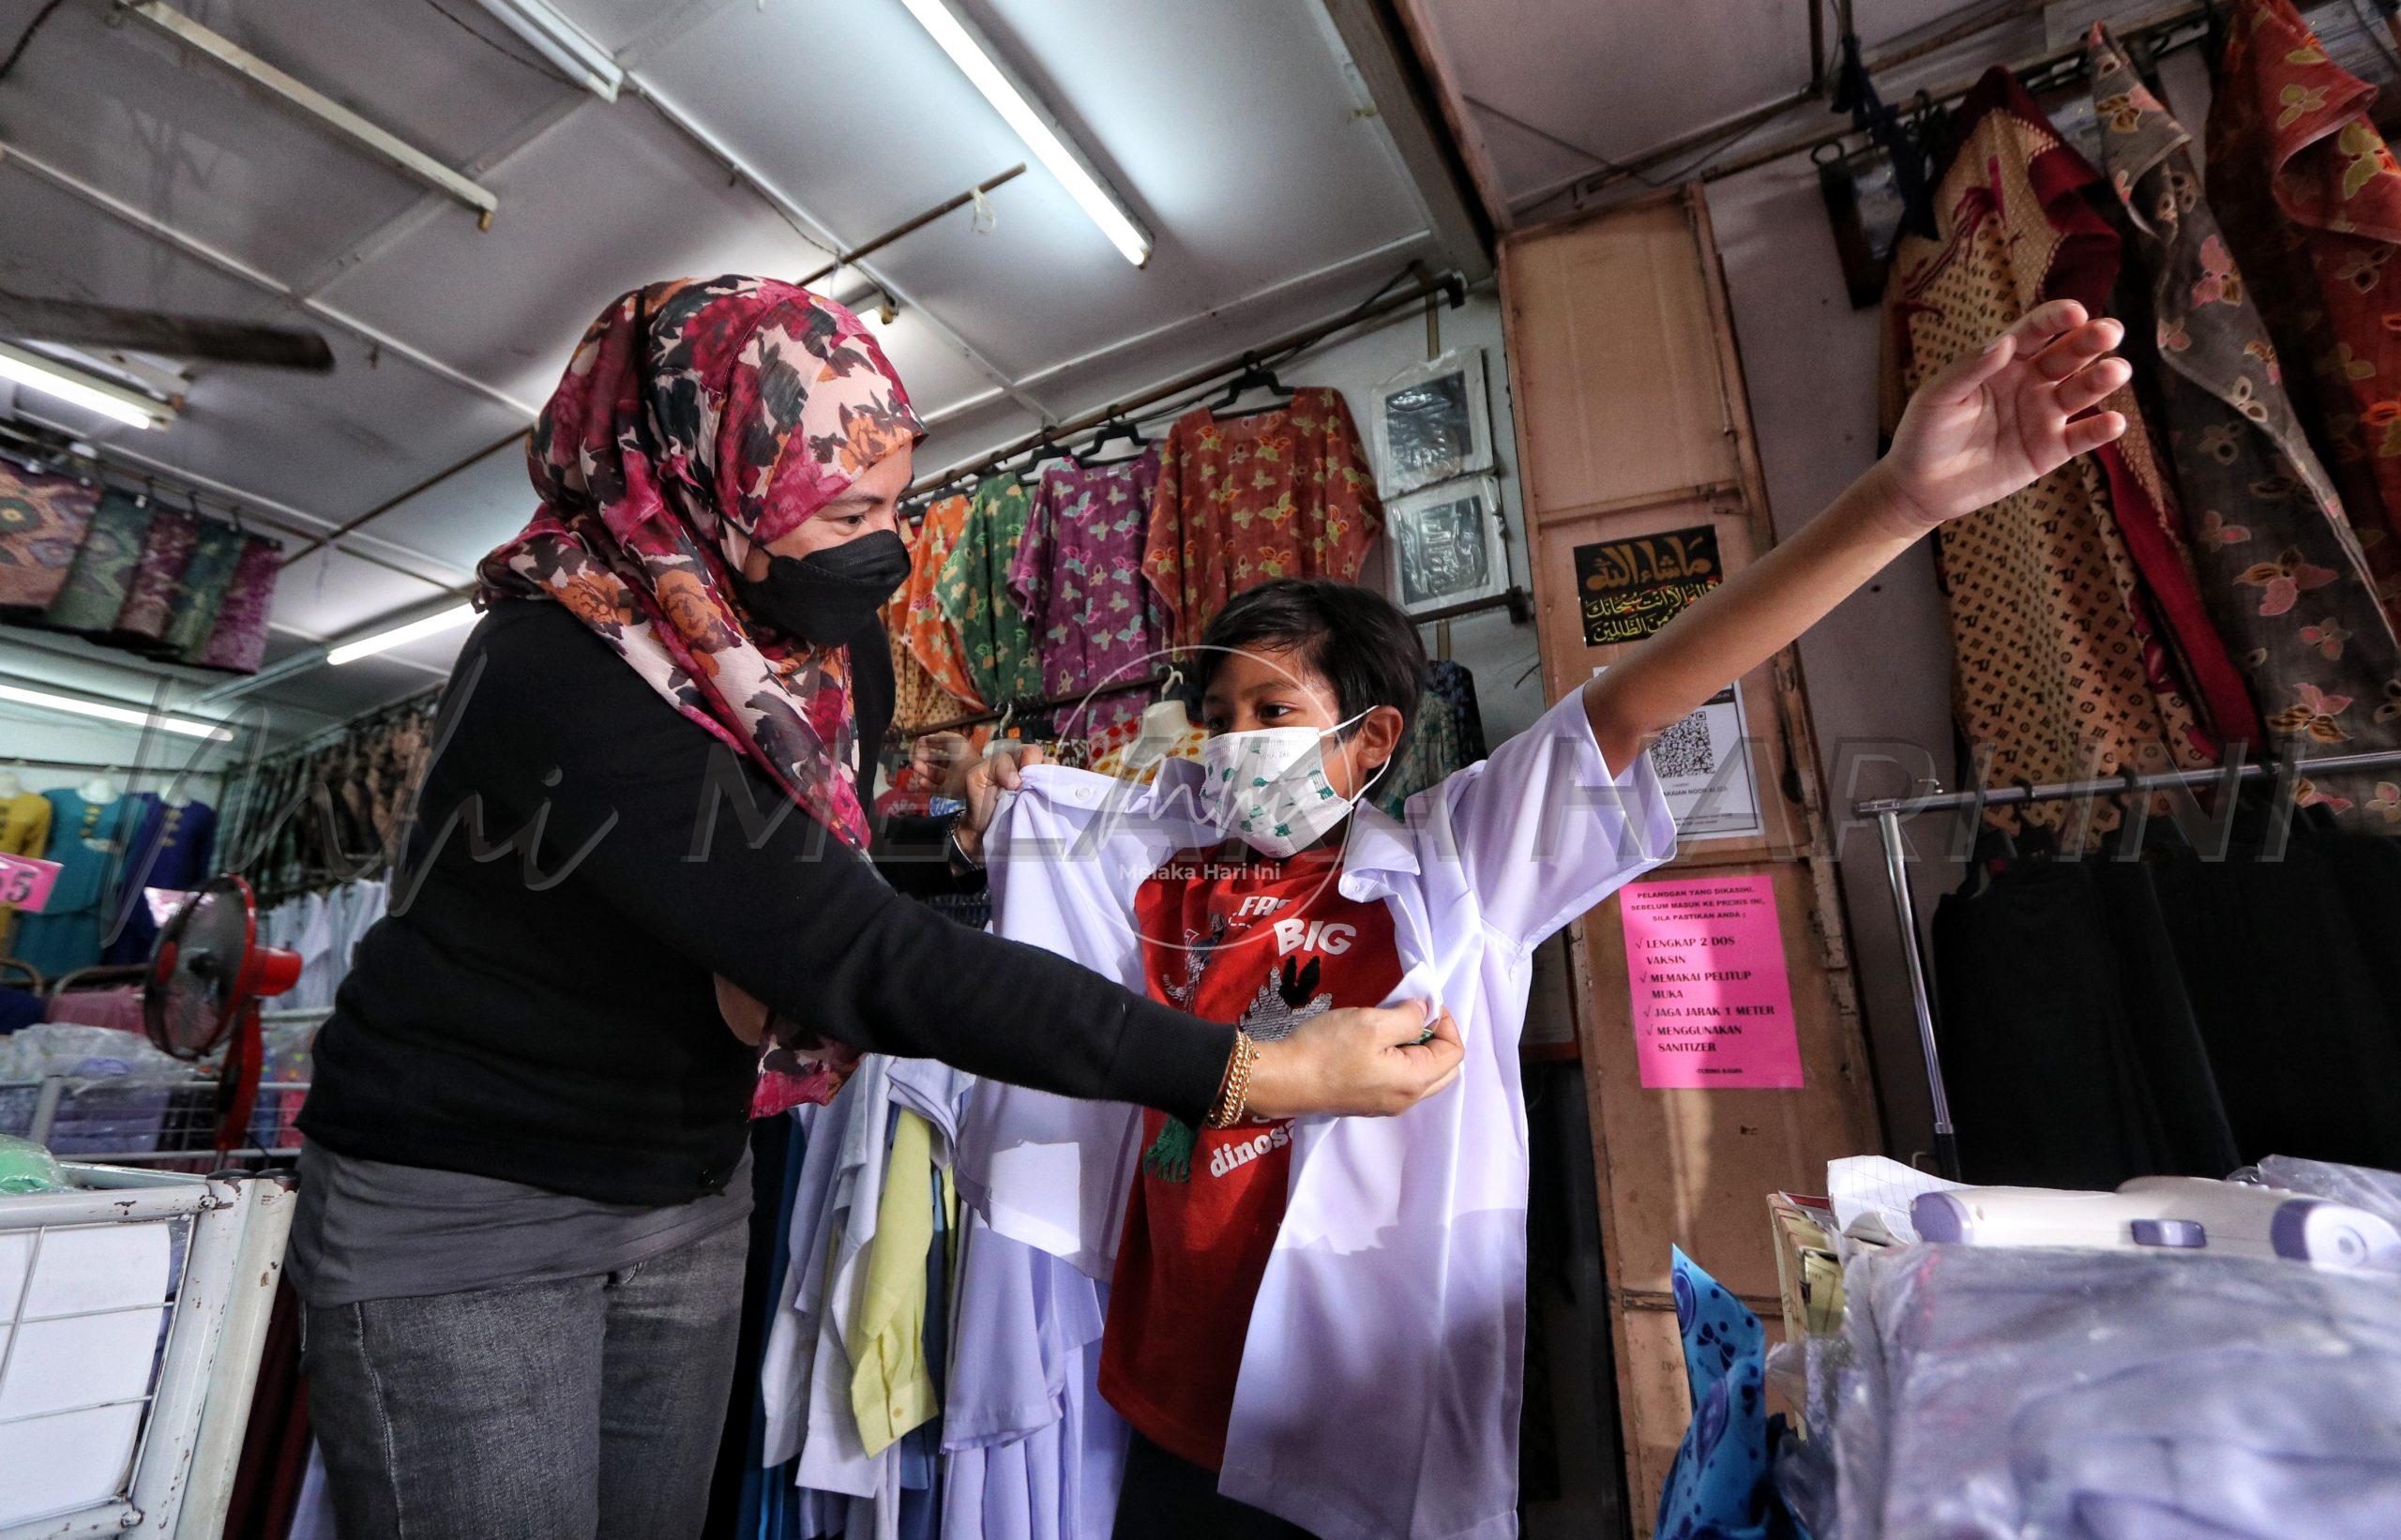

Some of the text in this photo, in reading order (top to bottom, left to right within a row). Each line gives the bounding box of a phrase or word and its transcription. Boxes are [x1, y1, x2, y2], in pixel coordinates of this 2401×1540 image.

[1638, 890, 1686, 898] PELANGGAN
[1273, 918, 1356, 957] BIG
[1646, 937, 1735, 948] LENGKAP 2 DOS
[1646, 955, 1685, 964] VAKSIN
[1651, 971, 1751, 983] MEMAKAI PELITUP
[1652, 989, 1684, 999] MUKA
[1654, 1007, 1682, 1017] JAGA
[1685, 1007, 1720, 1017] JARAK
[1736, 1005, 1774, 1015] METER
[1657, 1025, 1742, 1035] MENGGUNAKAN
[1658, 1042, 1716, 1052] SANITIZER
